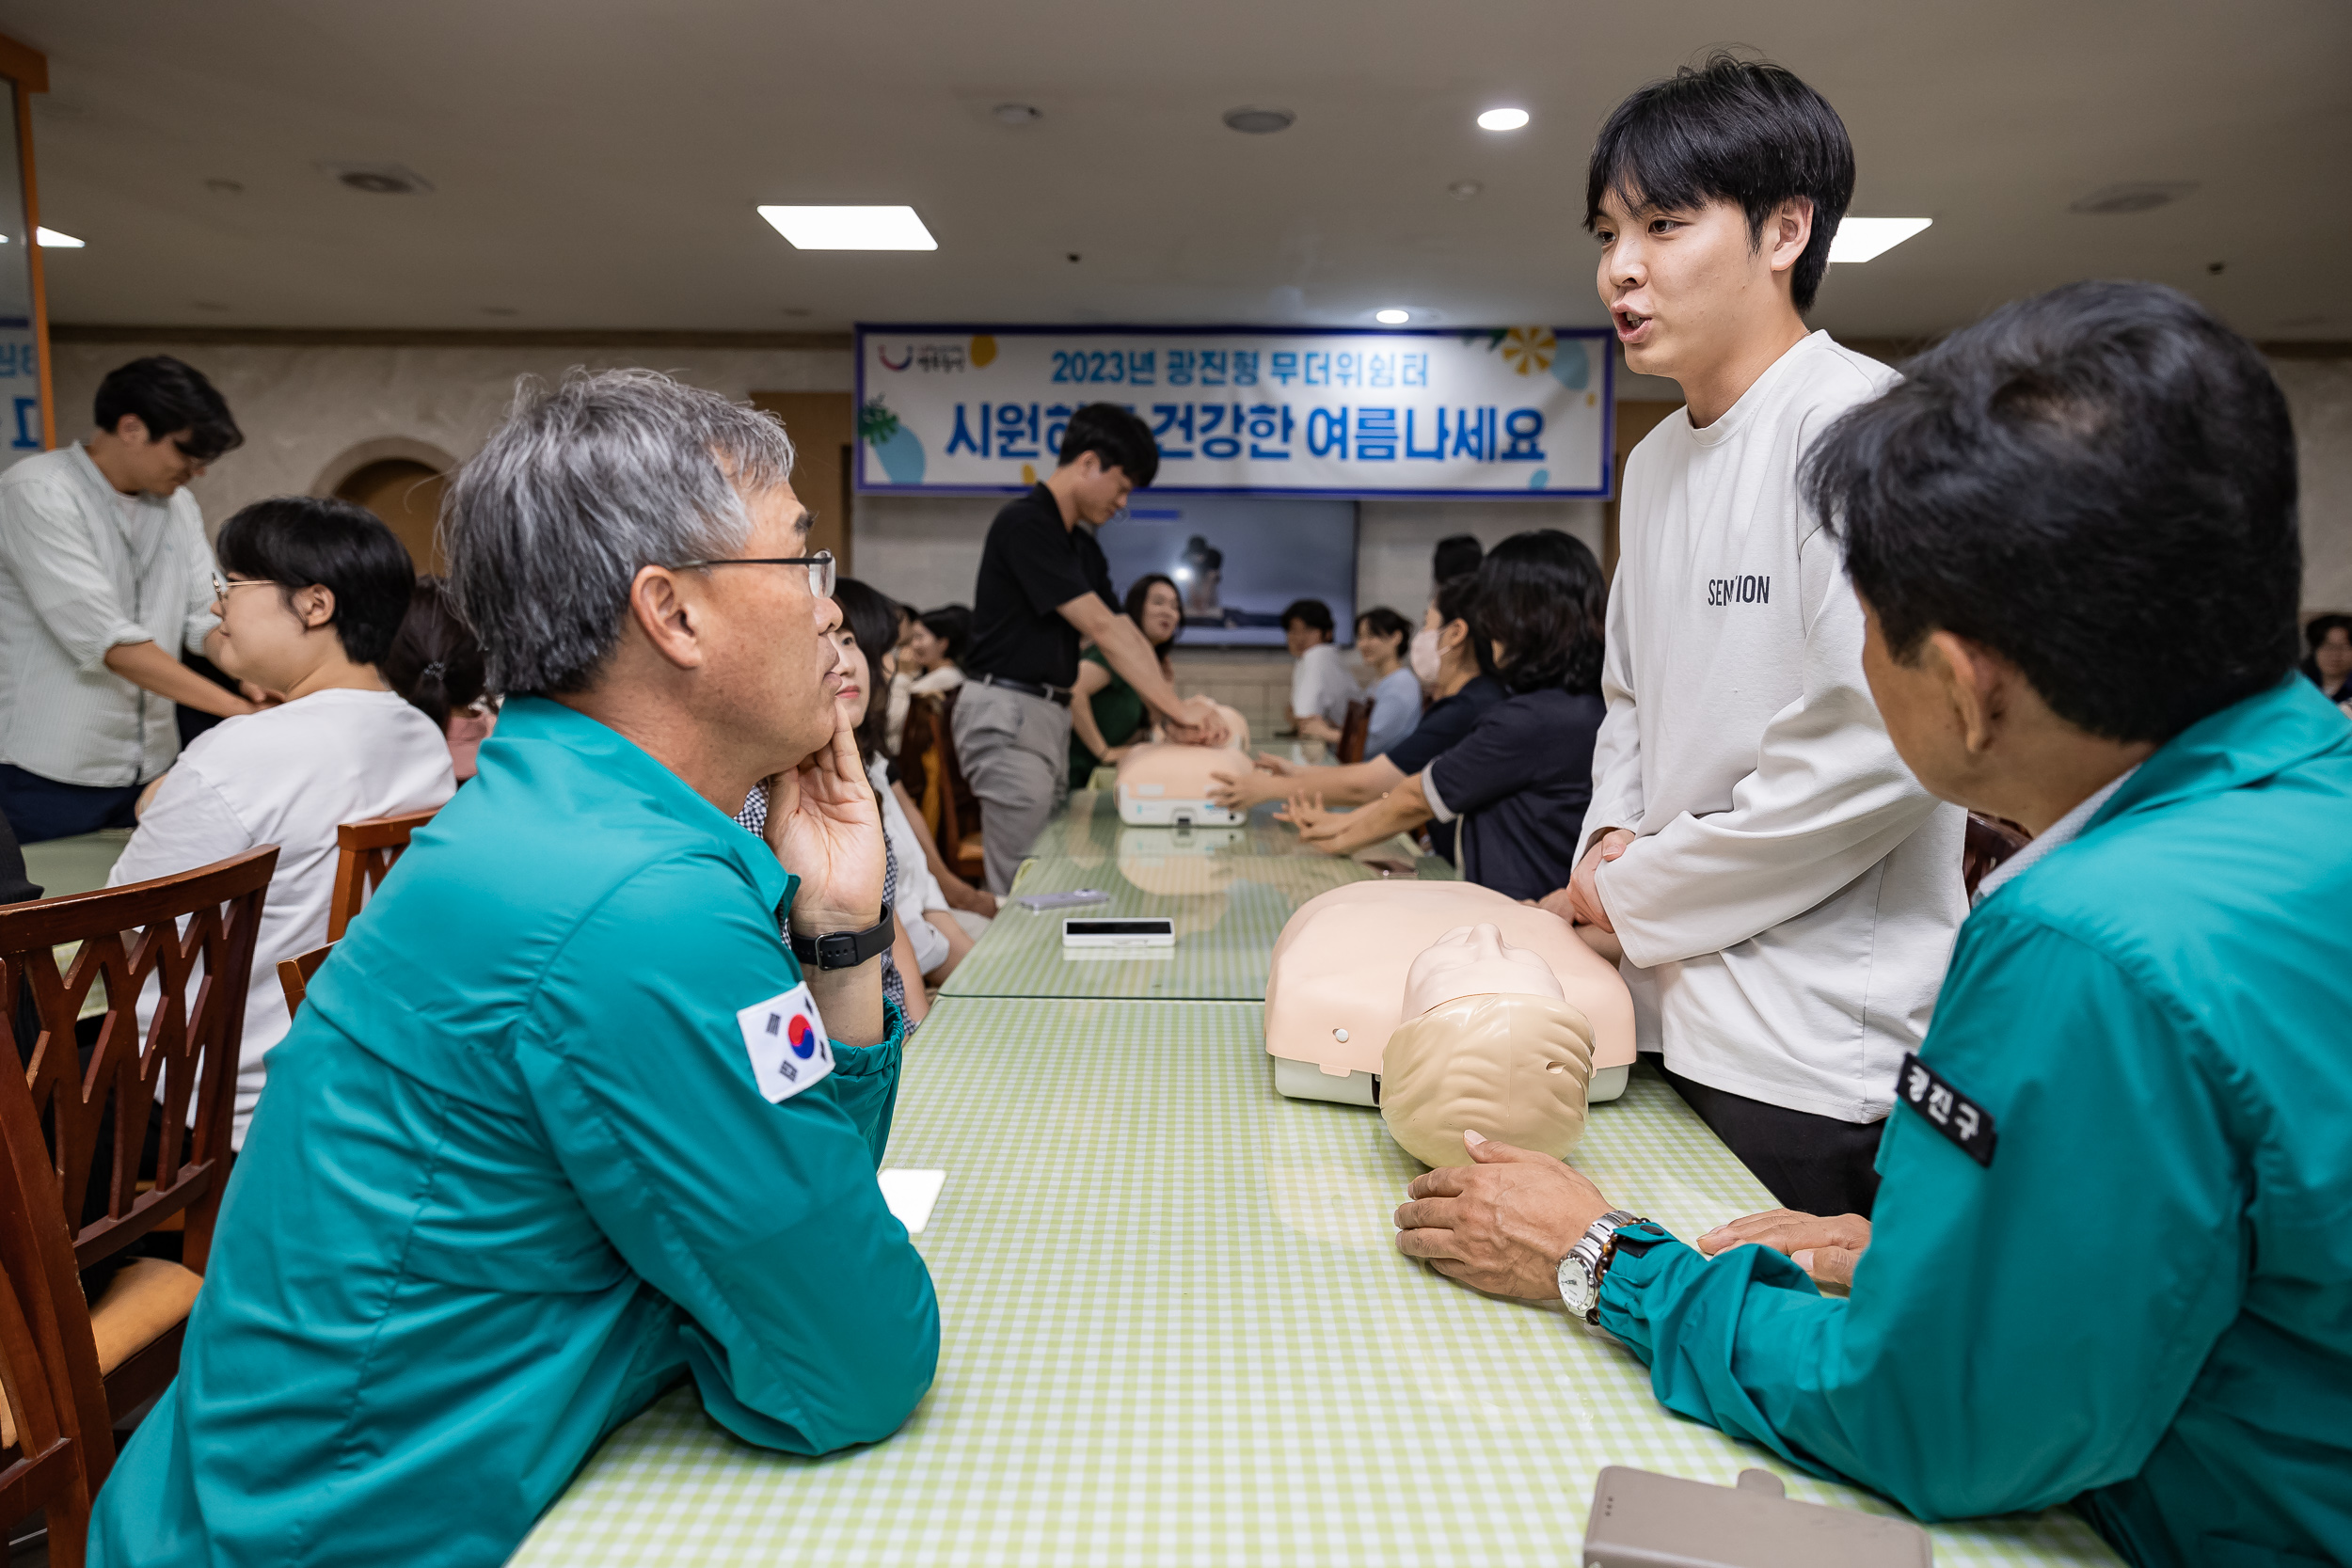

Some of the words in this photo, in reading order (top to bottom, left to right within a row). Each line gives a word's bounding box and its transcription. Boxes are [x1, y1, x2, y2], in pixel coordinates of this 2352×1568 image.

[1052, 351, 1155, 386] 2023년
[1168, 350, 1260, 387] 광진형
[1271, 350, 1428, 388] 무더위쉼터
[945, 403, 1136, 459] 시원하
[1152, 403, 1295, 460] 건강한
[1306, 404, 1546, 461] 여름나세요
